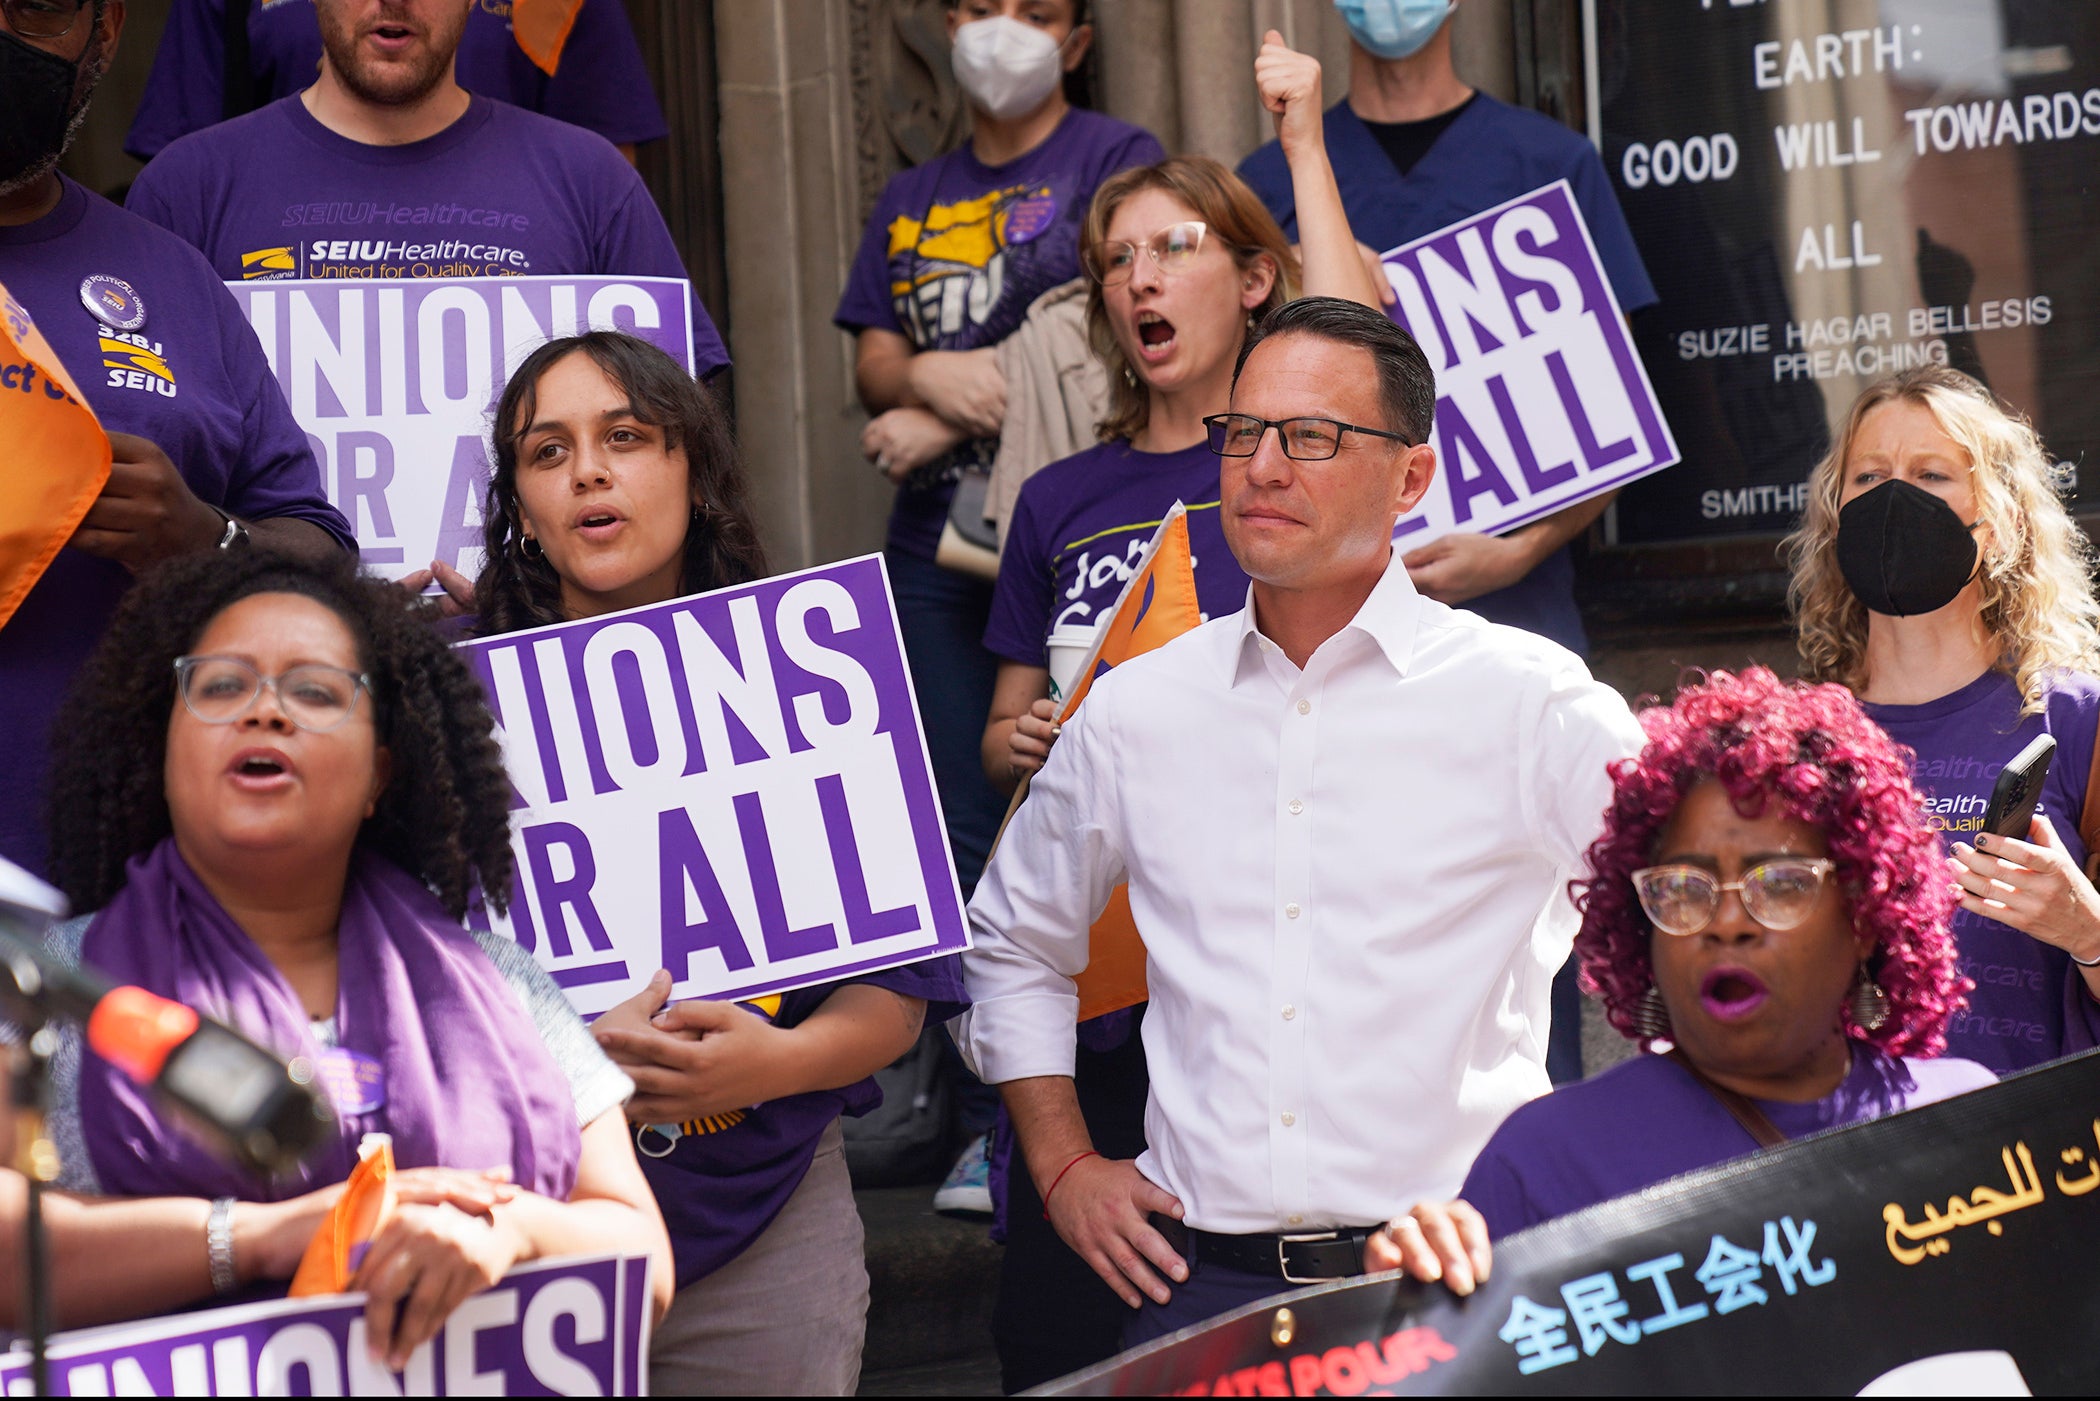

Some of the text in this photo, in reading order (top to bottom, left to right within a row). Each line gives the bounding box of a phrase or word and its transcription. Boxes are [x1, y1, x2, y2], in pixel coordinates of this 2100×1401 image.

[1754, 24, 1922, 90] EARTH:
[1622, 88, 2100, 189] GOOD WILL TOWARDS
[282, 201, 530, 232] SEIUHealthcare
[1796, 220, 1882, 272] ALL
[90, 275, 134, 297] POLITICAL
[309, 262, 367, 279] United
[380, 262, 404, 278] for
[411, 262, 480, 278] Quality
[1678, 295, 2053, 361] SUZIE HAGAR BELLESIS
[1773, 339, 1949, 382] PREACHING
[107, 368, 177, 398] SEIU
[1436, 349, 1638, 526] ALL
[1701, 482, 1810, 519] SMITHF
[487, 578, 881, 809] NIONS
[1926, 815, 1986, 832] Qualit
[658, 772, 922, 983] ALL
[1883, 1140, 2045, 1265] للجميع
[1498, 1215, 1838, 1375] 全民工会化
[1289, 1326, 1458, 1397] POUR
